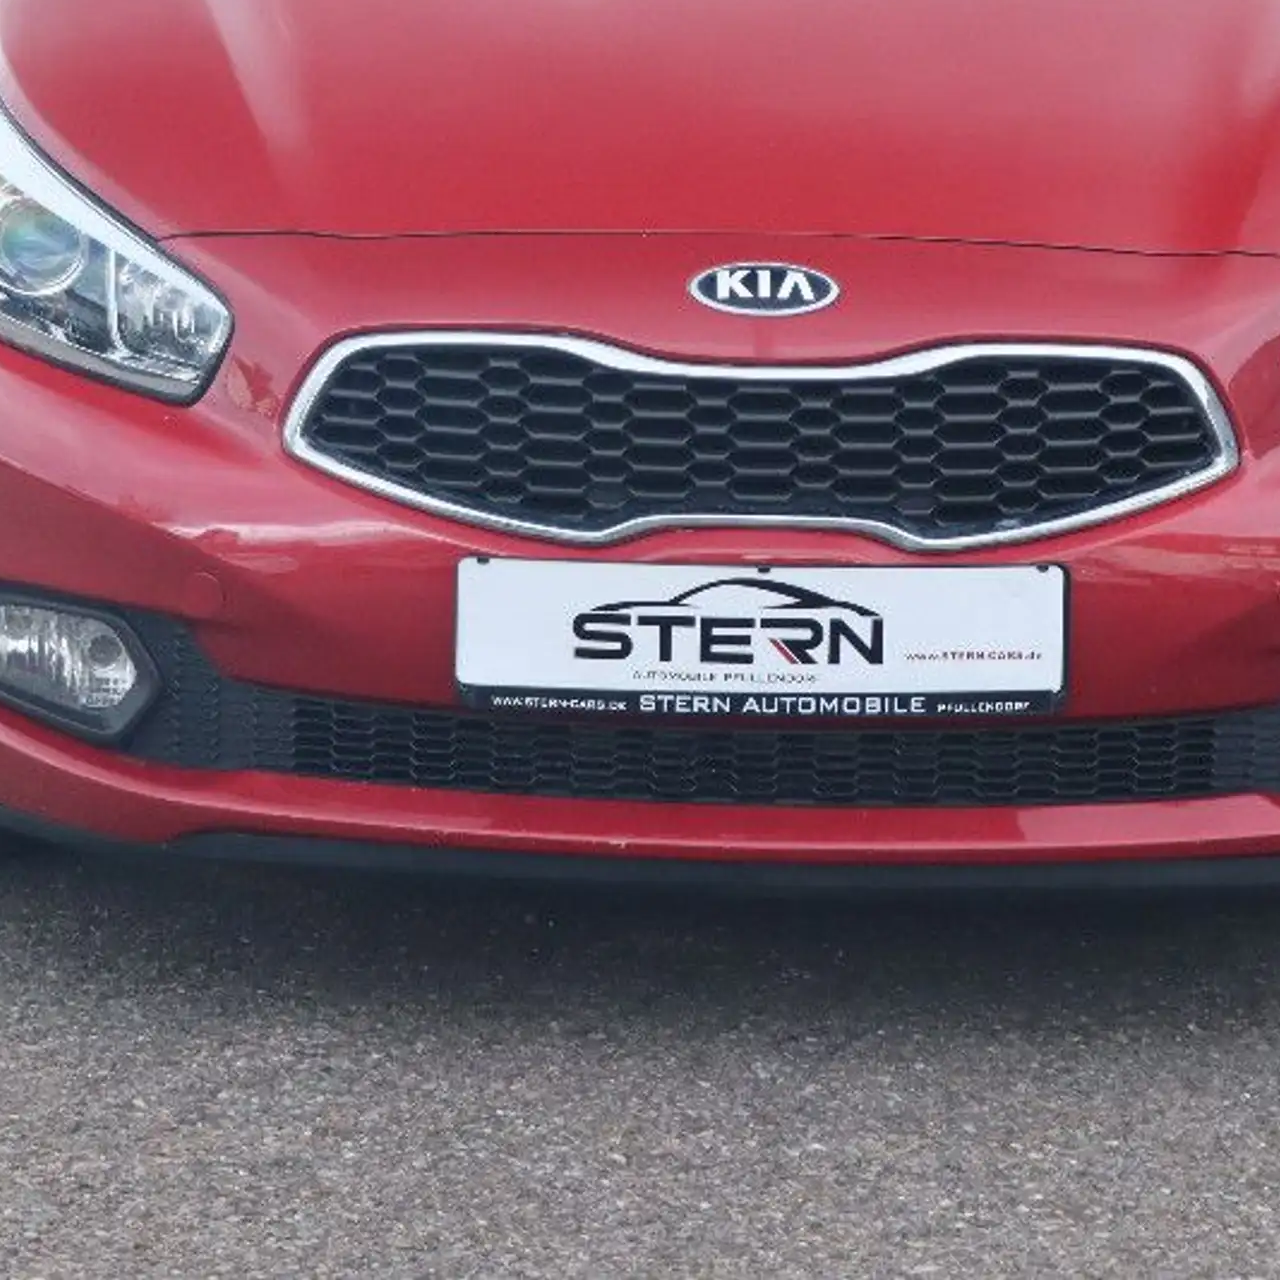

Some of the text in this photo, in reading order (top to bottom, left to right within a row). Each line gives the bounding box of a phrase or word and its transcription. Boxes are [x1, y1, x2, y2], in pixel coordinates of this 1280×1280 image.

[716, 269, 815, 301] KIA
[572, 612, 885, 665] STERN
[639, 693, 730, 713] STERN
[741, 695, 926, 714] AUTOMOBILE
